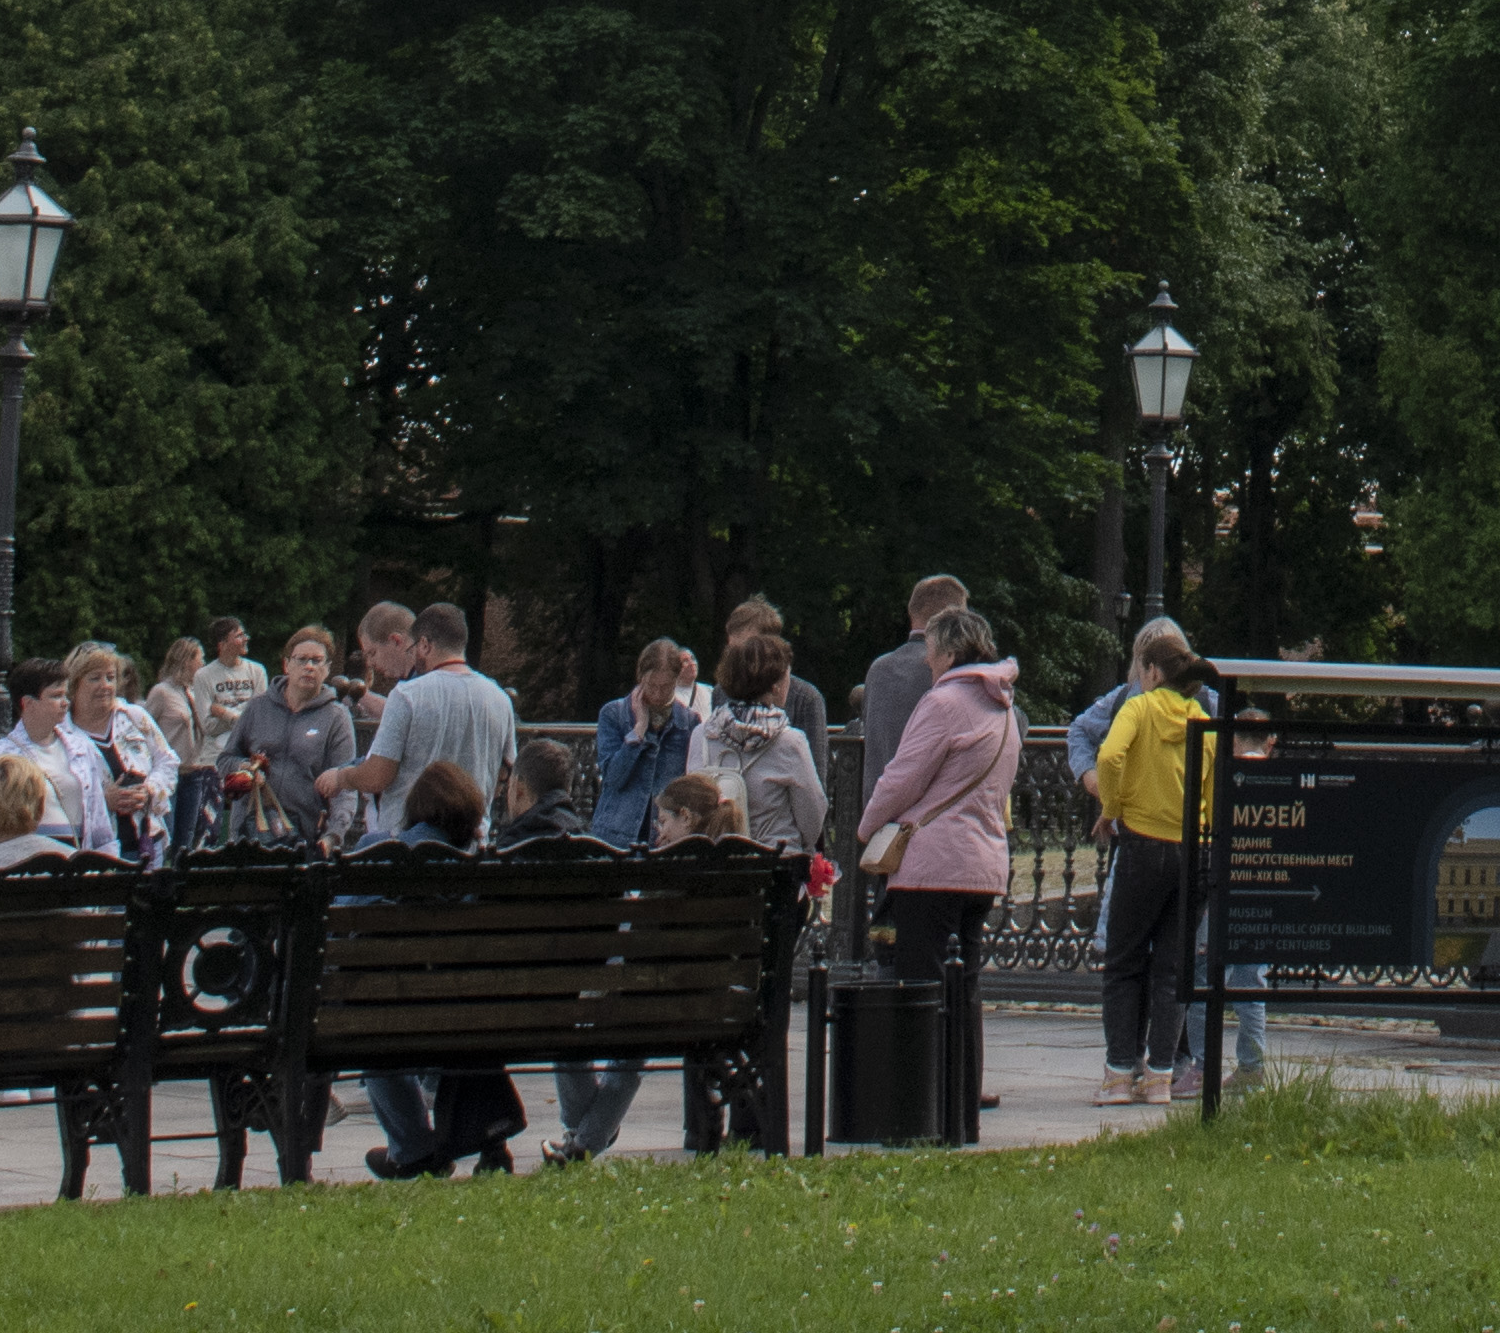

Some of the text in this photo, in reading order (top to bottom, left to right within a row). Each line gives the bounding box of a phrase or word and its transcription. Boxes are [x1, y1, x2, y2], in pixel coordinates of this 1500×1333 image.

[1232, 799, 1307, 828] МУЗЕЙ
[1231, 837, 1273, 851] ЗДАНИЕ
[1230, 853, 1354, 867] ПРИСУТСТВЕННЫХ МЕСТ
[1228, 907, 1273, 919] MUSEUM
[1228, 923, 1393, 936] FORMER PUBLIC OFFICE BUILDING
[1275, 939, 1332, 951] CENTURIES
